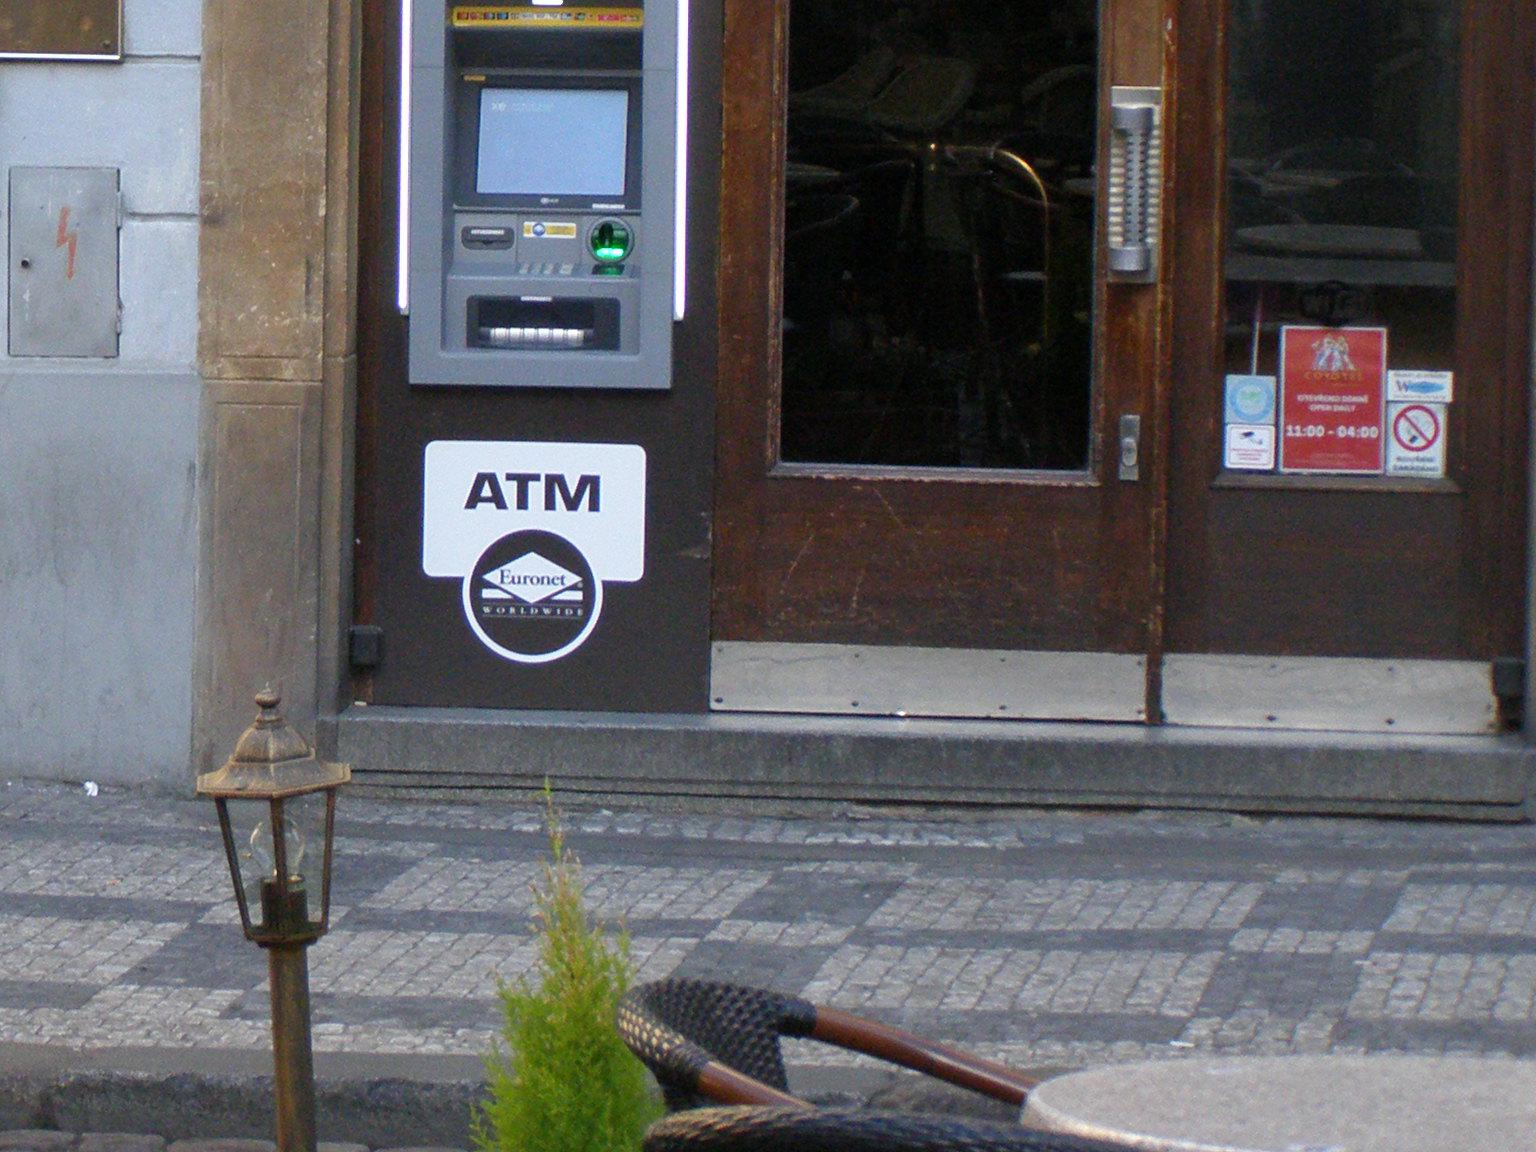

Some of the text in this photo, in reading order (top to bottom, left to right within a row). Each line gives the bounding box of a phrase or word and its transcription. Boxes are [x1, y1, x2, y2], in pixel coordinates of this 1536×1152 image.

[464, 472, 601, 513] ATM
[499, 569, 566, 587] Euronet
[482, 605, 583, 616] WORLDWIDE
